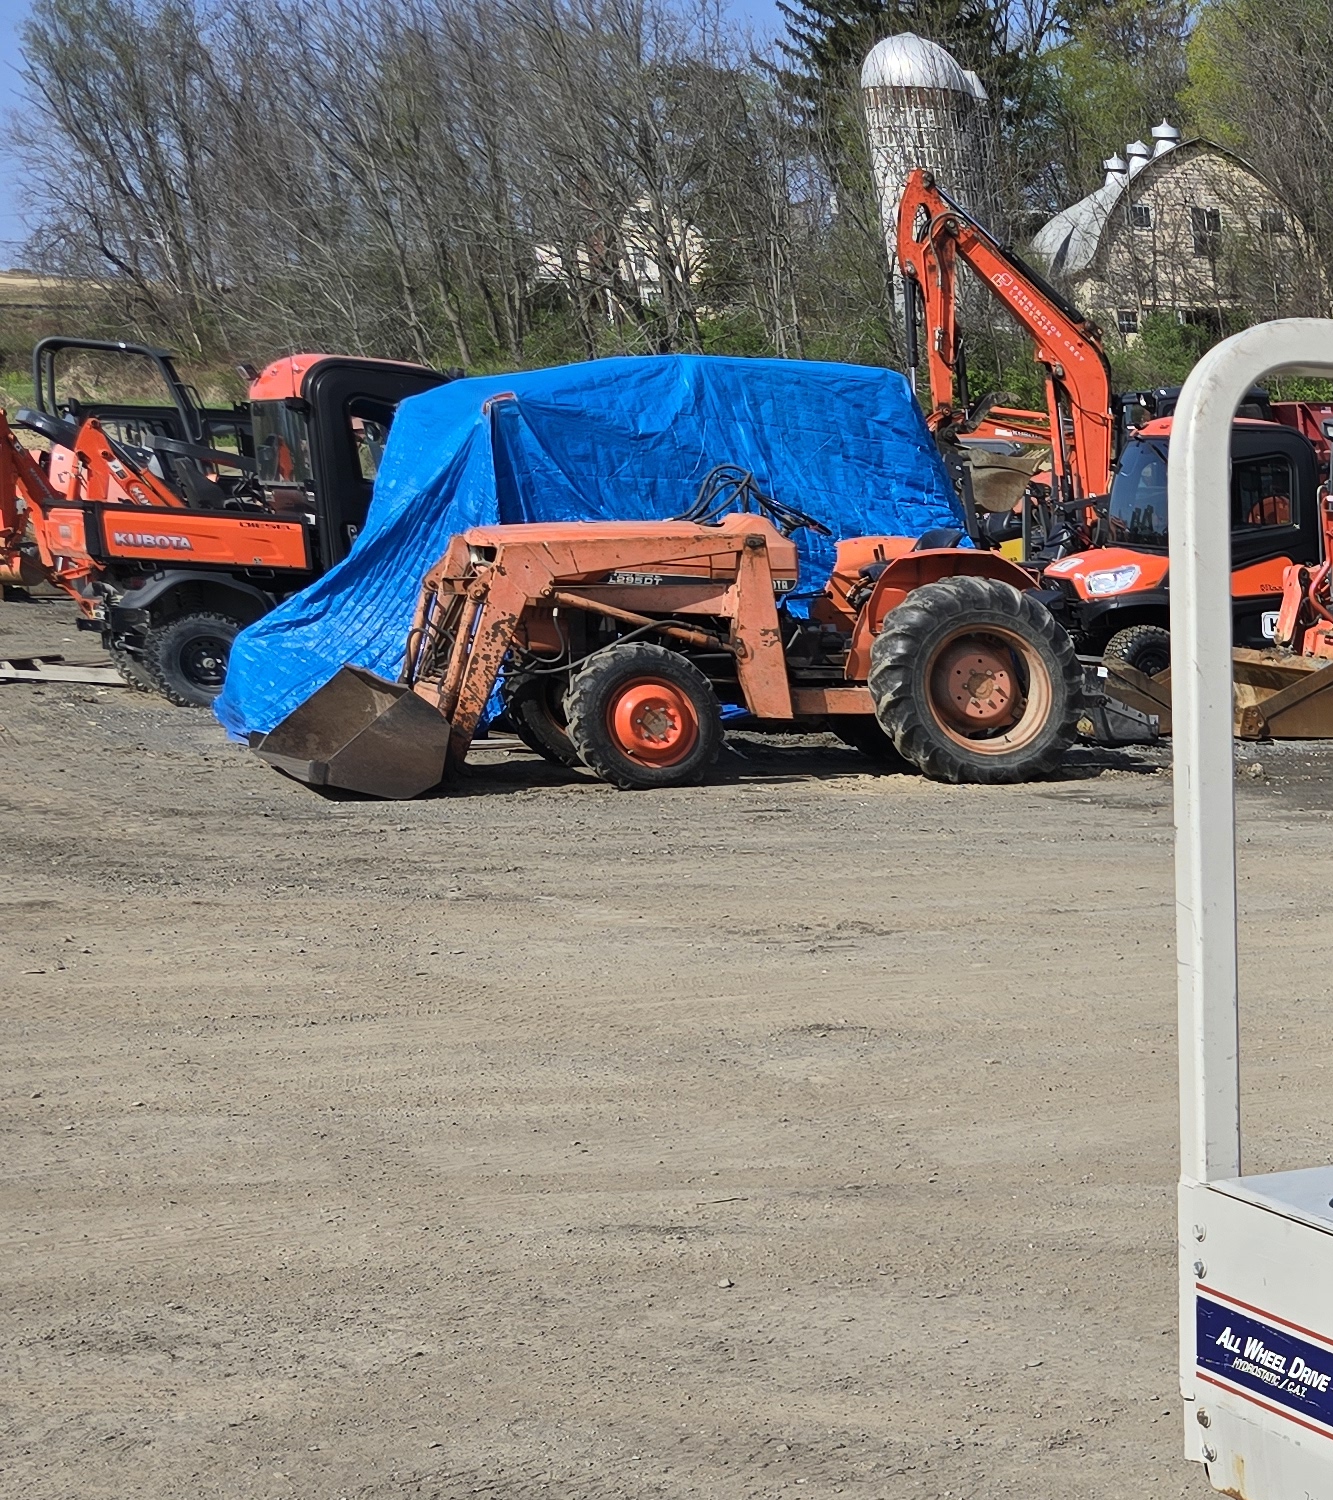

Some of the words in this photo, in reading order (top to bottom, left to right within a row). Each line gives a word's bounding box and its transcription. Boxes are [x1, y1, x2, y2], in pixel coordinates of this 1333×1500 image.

[1008, 289, 1052, 336] LANDSCAPE
[1012, 285, 1062, 338] PENNINGTON
[113, 532, 193, 551] KUBOTA
[1215, 1326, 1242, 1354] ALL
[1243, 1336, 1287, 1375] WHEEL
[1287, 1356, 1332, 1393] DRIVE
[1232, 1356, 1281, 1388] HYDROSTATIC
